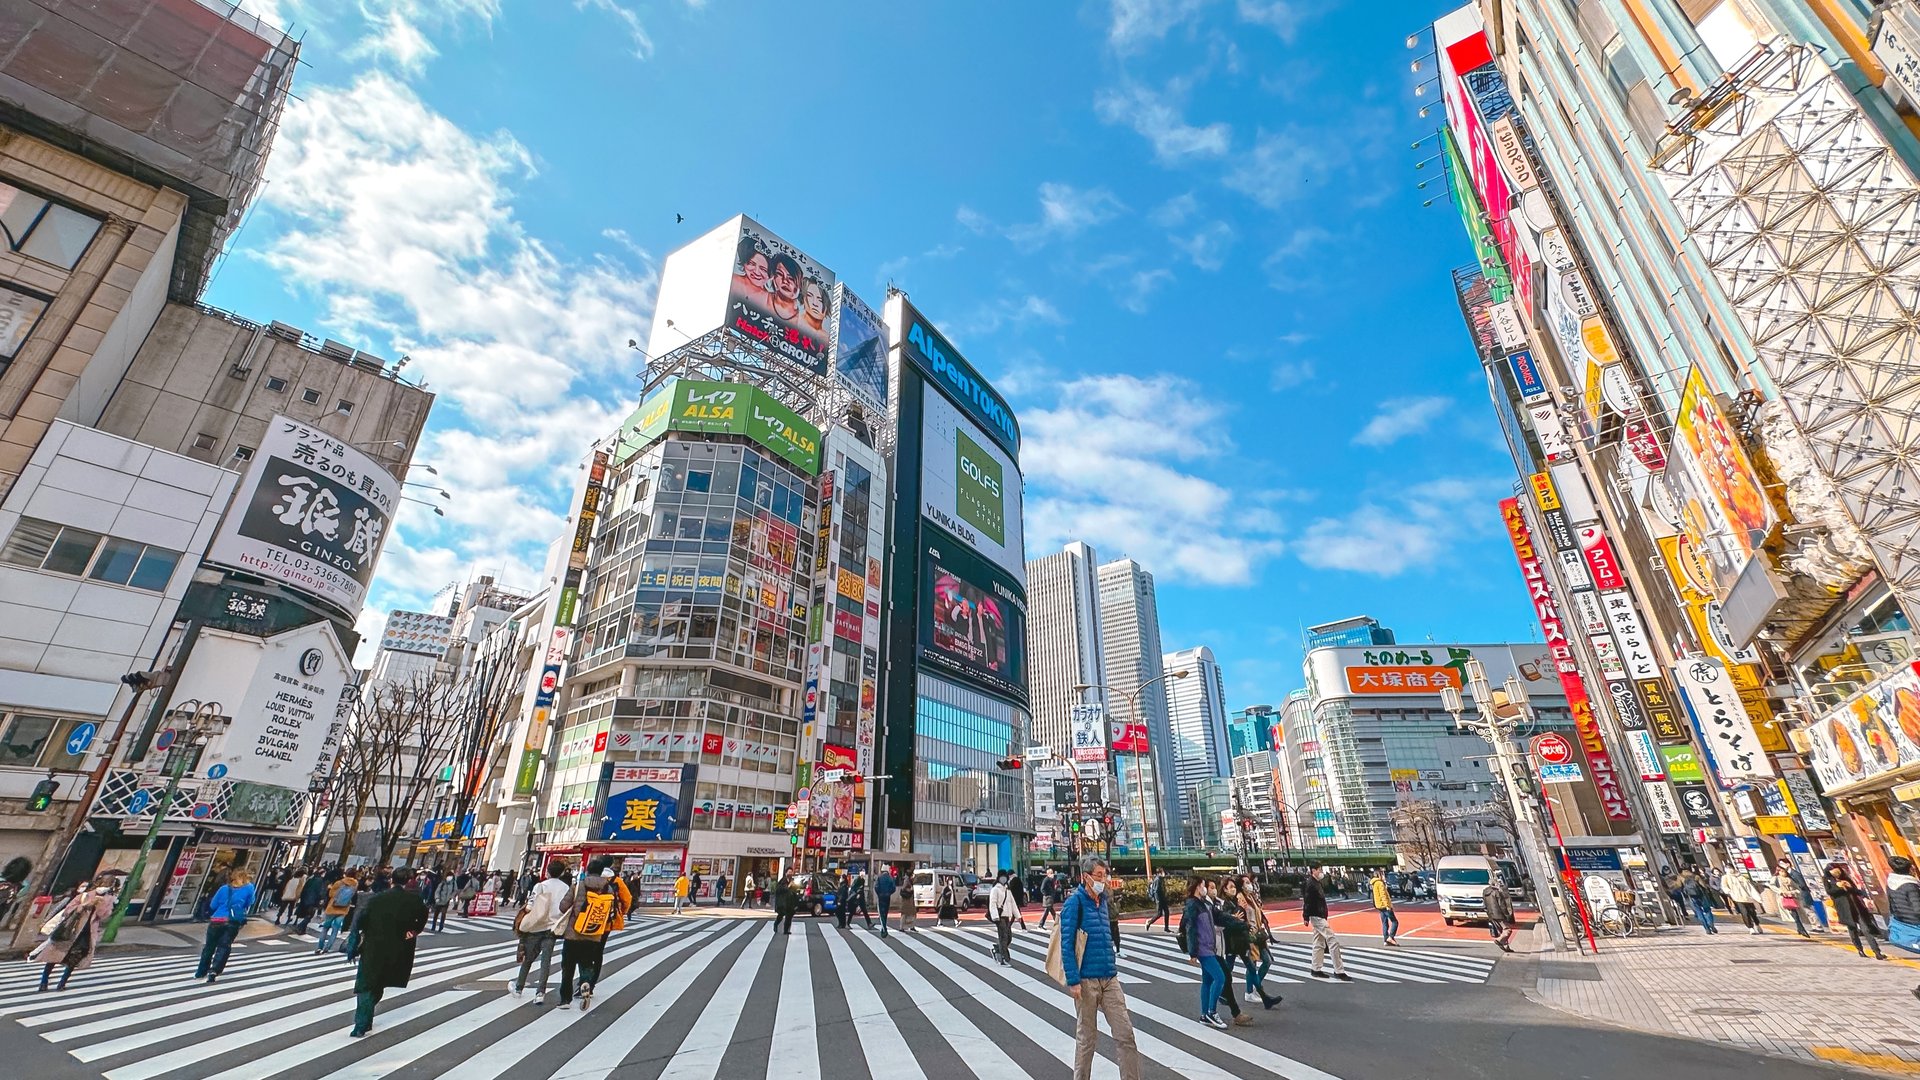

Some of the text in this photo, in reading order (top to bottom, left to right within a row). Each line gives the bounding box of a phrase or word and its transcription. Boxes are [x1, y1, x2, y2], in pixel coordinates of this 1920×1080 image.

[780, 341, 819, 367] GROUP
[1516, 356, 1535, 386] PROMISE
[686, 388, 737, 405] レイク
[683, 405, 734, 420] ALSA
[282, 422, 345, 458] ブランド品
[960, 455, 999, 498] GOLF5
[960, 488, 1001, 521] FLAGSHIP
[926, 503, 957, 535] YUNIKA
[976, 510, 1001, 533] STORE
[1558, 527, 1572, 547] STAND
[240, 553, 326, 590] http://ginzo.jp
[1590, 549, 1614, 578] アコム
[1505, 503, 1535, 560] パチンコ
[1524, 561, 1564, 641] エスパス
[672, 575, 694, 586] 祝日
[698, 575, 722, 588] 夜間
[1603, 579, 1615, 587] 3F
[993, 581, 1017, 604] YUNIKA
[403, 611, 444, 625] オカダヤ
[794, 604, 806, 618] 6F
[401, 621, 442, 634] オカダヤ
[397, 631, 439, 643] オカダヤ
[1610, 598, 1651, 674] 東京ぶらんど
[393, 640, 436, 652] オカダヤ
[1363, 650, 1433, 666] たのめーる
[1734, 650, 1753, 659] B1
[1357, 671, 1452, 688] 大塚商会
[1692, 663, 1716, 682] 虎
[1644, 683, 1663, 704] 買取
[265, 700, 315, 721] LOUIS VUITTON
[1073, 706, 1101, 722] カラオケ
[272, 714, 303, 729] ROLEX
[1085, 722, 1091, 731] の
[1656, 713, 1676, 735] 販売
[266, 725, 300, 739] Cartier
[643, 734, 698, 746] アイフル
[1077, 731, 1101, 746] 鉄人
[258, 735, 300, 752] BVLGARI
[572, 738, 594, 752] アイフル
[596, 735, 605, 749] 3F
[707, 740, 719, 751] 3F
[1540, 744, 1565, 756] 消火栓
[255, 747, 292, 762] CHANEL
[1574, 700, 1628, 820] パチンコ エスパス
[1665, 753, 1692, 763] レイク
[614, 768, 680, 782] ミネドラッグ
[620, 799, 659, 832] 薬
[716, 803, 769, 816] ミネドラッグ
[774, 810, 787, 830] 薬
[1565, 849, 1611, 857] UBNADE
